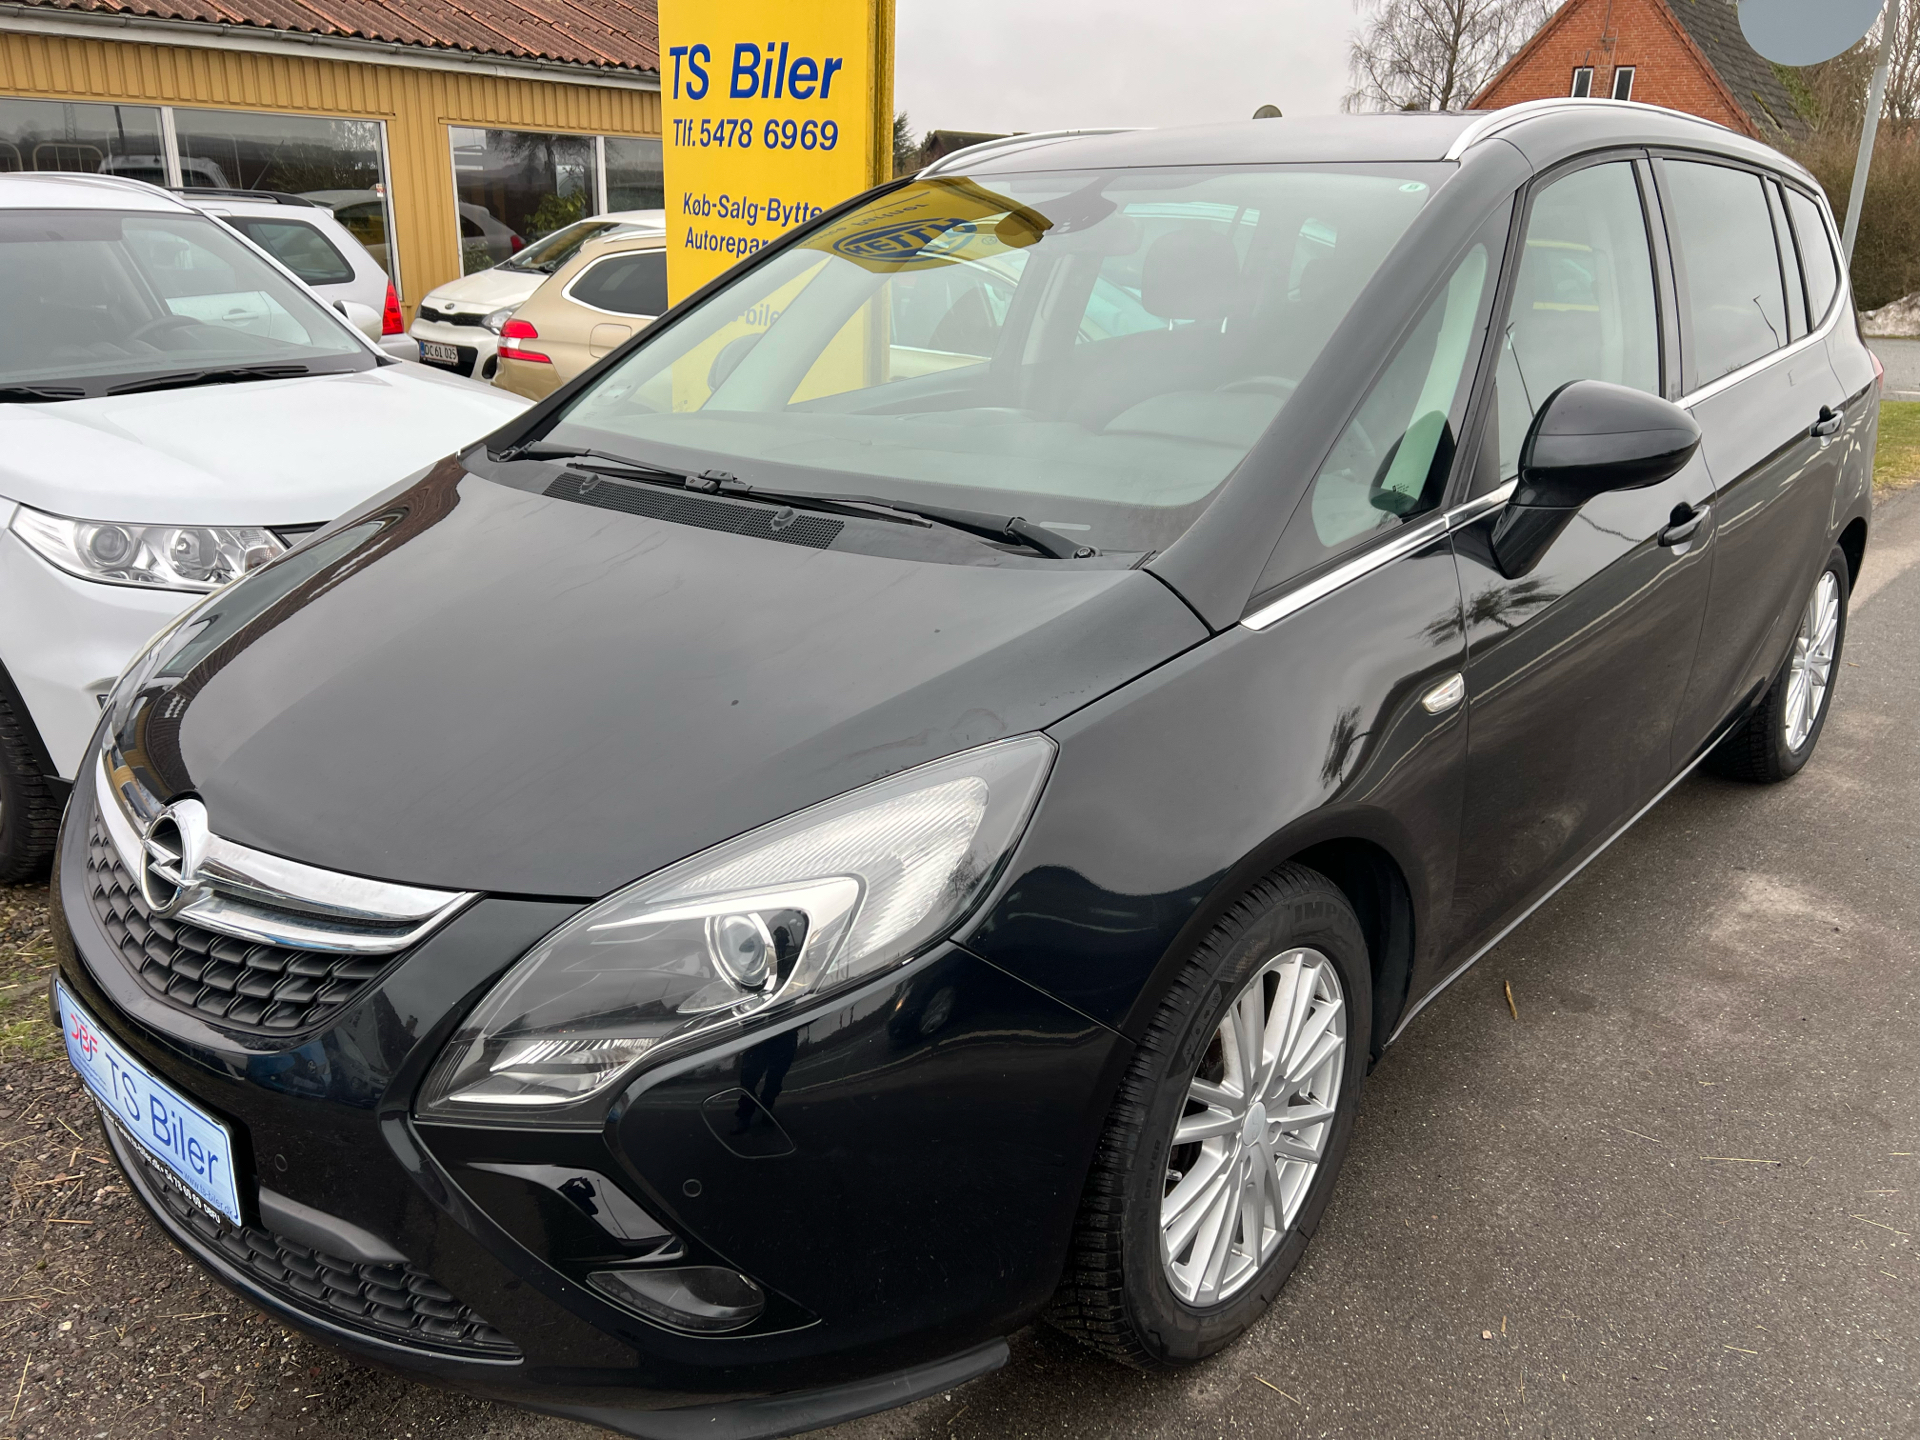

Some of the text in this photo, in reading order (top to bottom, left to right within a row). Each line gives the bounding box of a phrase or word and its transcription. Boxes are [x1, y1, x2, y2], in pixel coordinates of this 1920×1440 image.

[669, 42, 843, 100] TS Biler
[673, 118, 838, 150] Tlf. 5478 6969
[105, 1052, 141, 1122] TS
[149, 1093, 218, 1184] Biler
